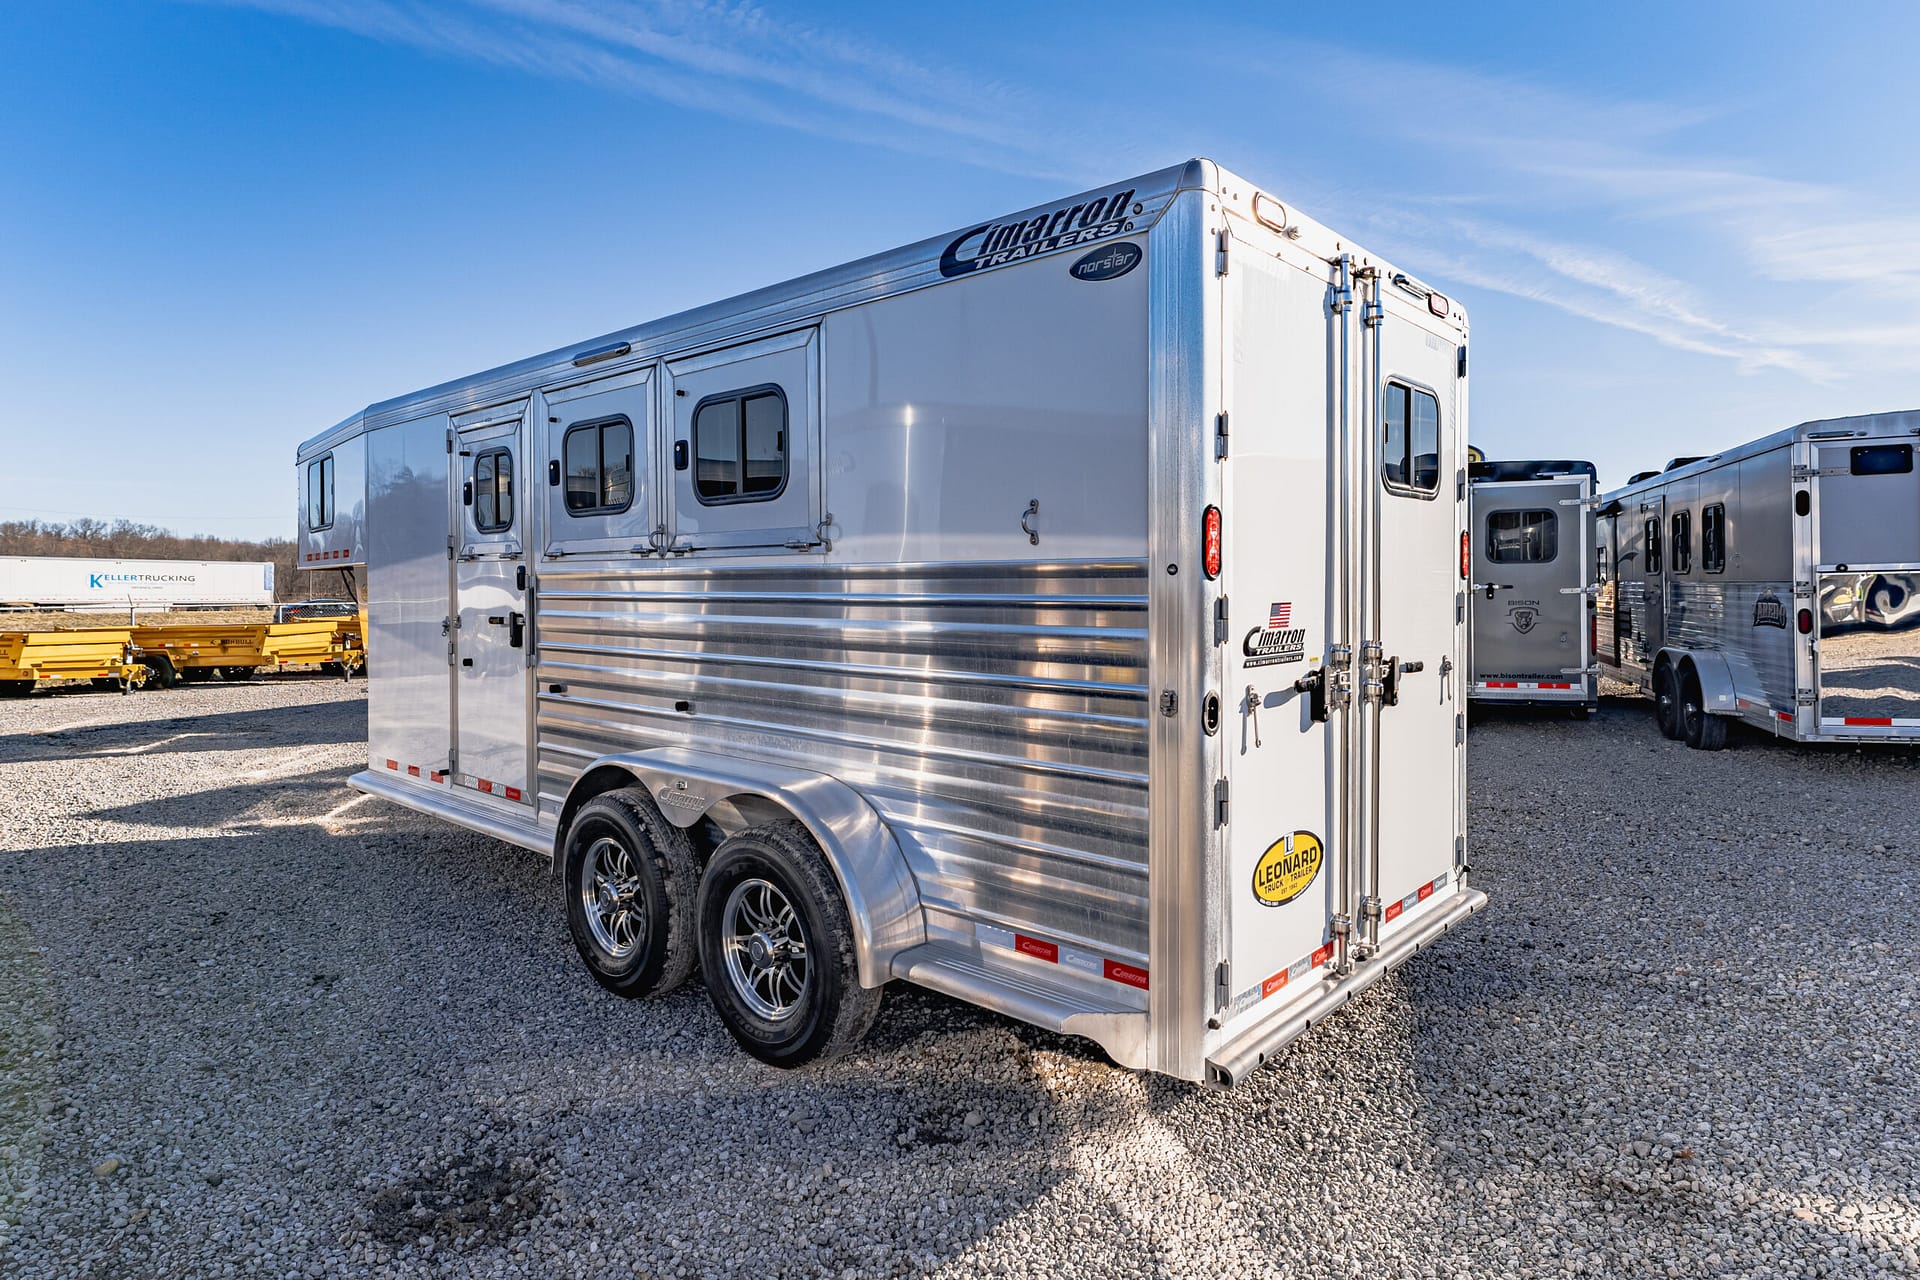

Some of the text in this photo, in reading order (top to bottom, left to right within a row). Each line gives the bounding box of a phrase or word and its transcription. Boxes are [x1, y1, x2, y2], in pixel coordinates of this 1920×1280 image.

[940, 188, 1136, 278] Cimarron
[974, 220, 1120, 270] TRAILERS
[1078, 247, 1134, 275] norstar
[1243, 626, 1305, 657] Cimarron
[1256, 643, 1302, 655] TRAILERS
[1480, 672, 1564, 680] www.bisontrailer.com
[1258, 846, 1317, 887] LEONARD
[1264, 879, 1284, 894] TRUCK
[1290, 865, 1313, 882] TRAILER
[1112, 967, 1147, 985] Cimarron
